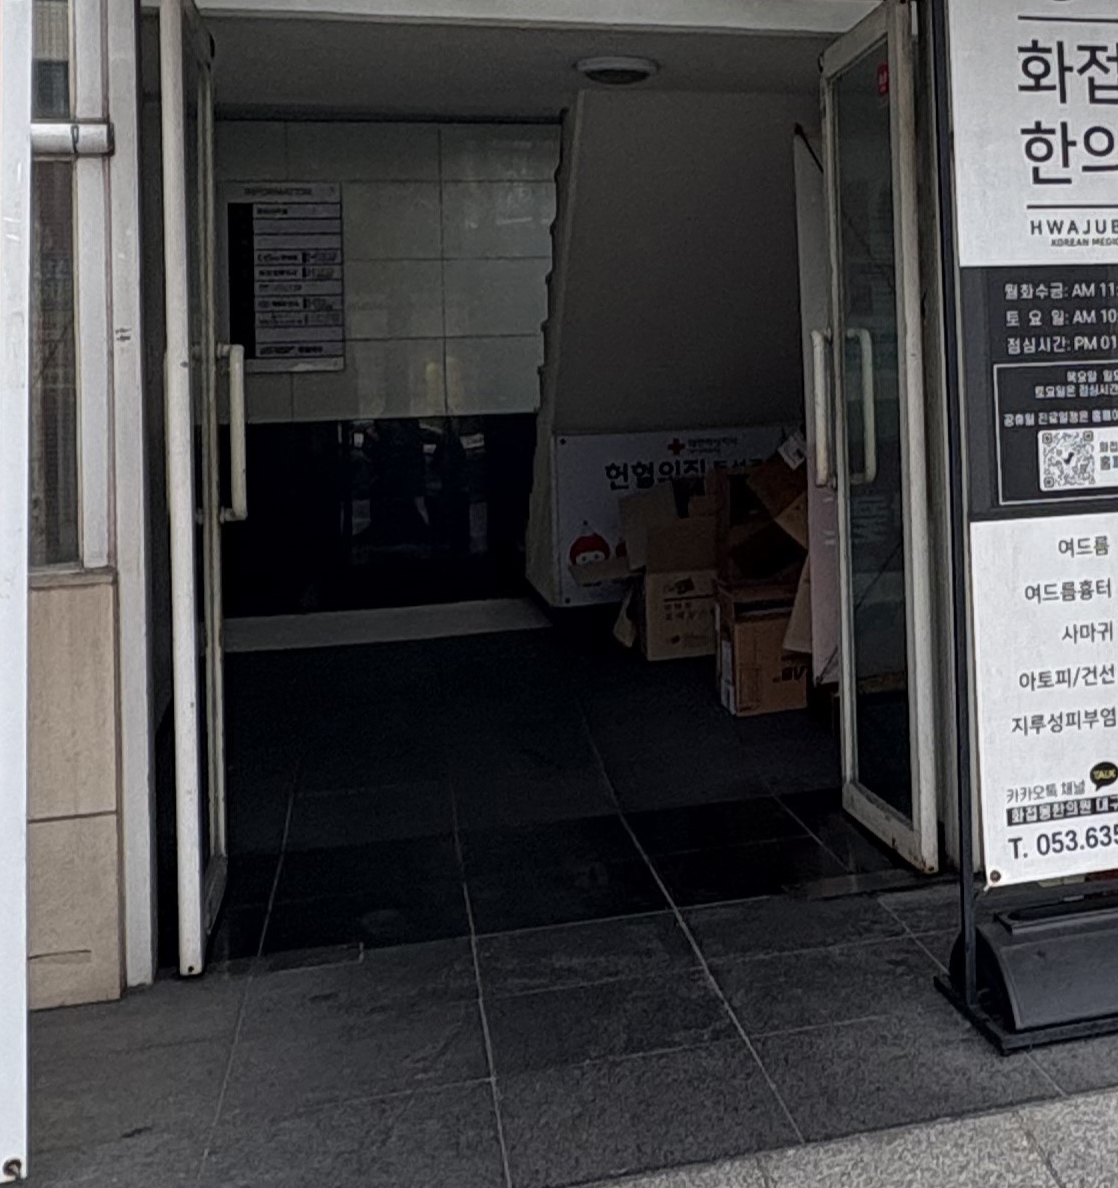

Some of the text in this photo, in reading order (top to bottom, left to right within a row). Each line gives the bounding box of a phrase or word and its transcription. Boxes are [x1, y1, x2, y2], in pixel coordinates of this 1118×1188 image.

[1051, 238, 1089, 247] KOREAN
[1072, 283, 1095, 297] AM
[1072, 310, 1097, 324] AM
[1074, 336, 1097, 351] PM
[1035, 385, 1076, 399] 토요일은
[1079, 383, 1118, 397] 점심시간
[1003, 413, 1035, 427] 공휴일
[1058, 535, 1110, 558] 여드름
[1024, 578, 1112, 604] 여드름흉터
[1062, 621, 1114, 645] 사마귀
[1019, 663, 1116, 692] 아토피/건선
[1011, 707, 1118, 736] 지루성피부염
[1093, 769, 1117, 780] TALK
[1006, 779, 1085, 804] 카카오톡 채널
[1011, 799, 1092, 824] 화접몽한의원
[1008, 837, 1028, 859] T.
